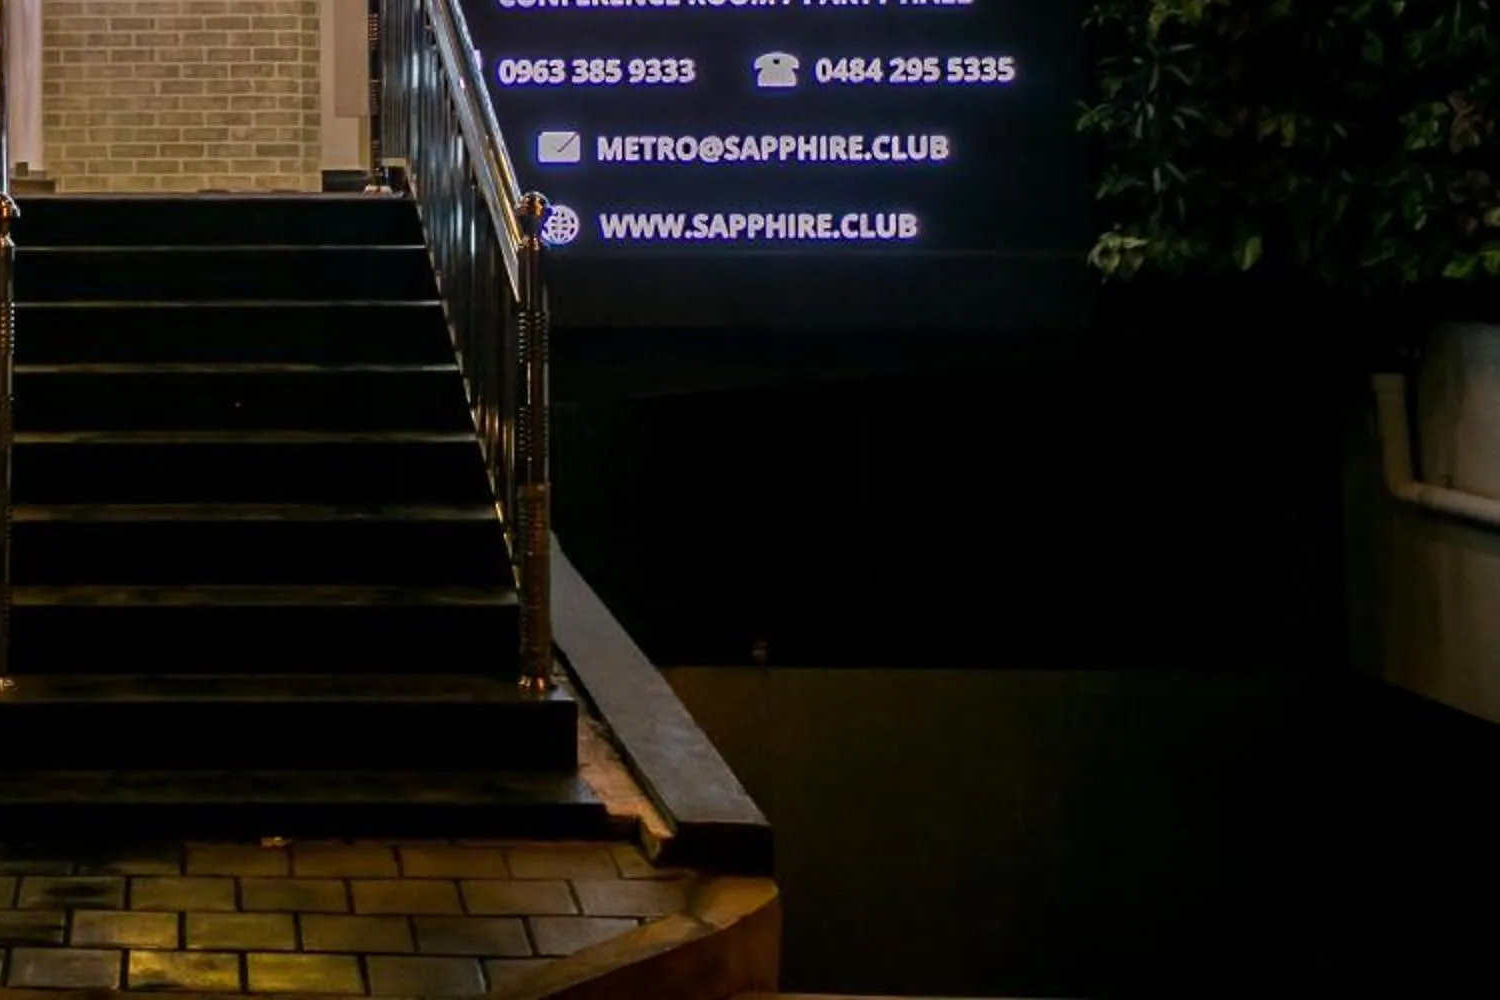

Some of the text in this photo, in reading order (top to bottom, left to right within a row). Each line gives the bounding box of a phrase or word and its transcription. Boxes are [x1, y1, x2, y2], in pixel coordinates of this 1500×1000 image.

[498, 57, 696, 85] 0963 385 9333
[815, 56, 1016, 83] 0484 295 5335
[597, 134, 950, 163] METRO@SAPPHIRE.CLUB
[599, 212, 918, 239] WWW.SAPPHIRE.CLUB
